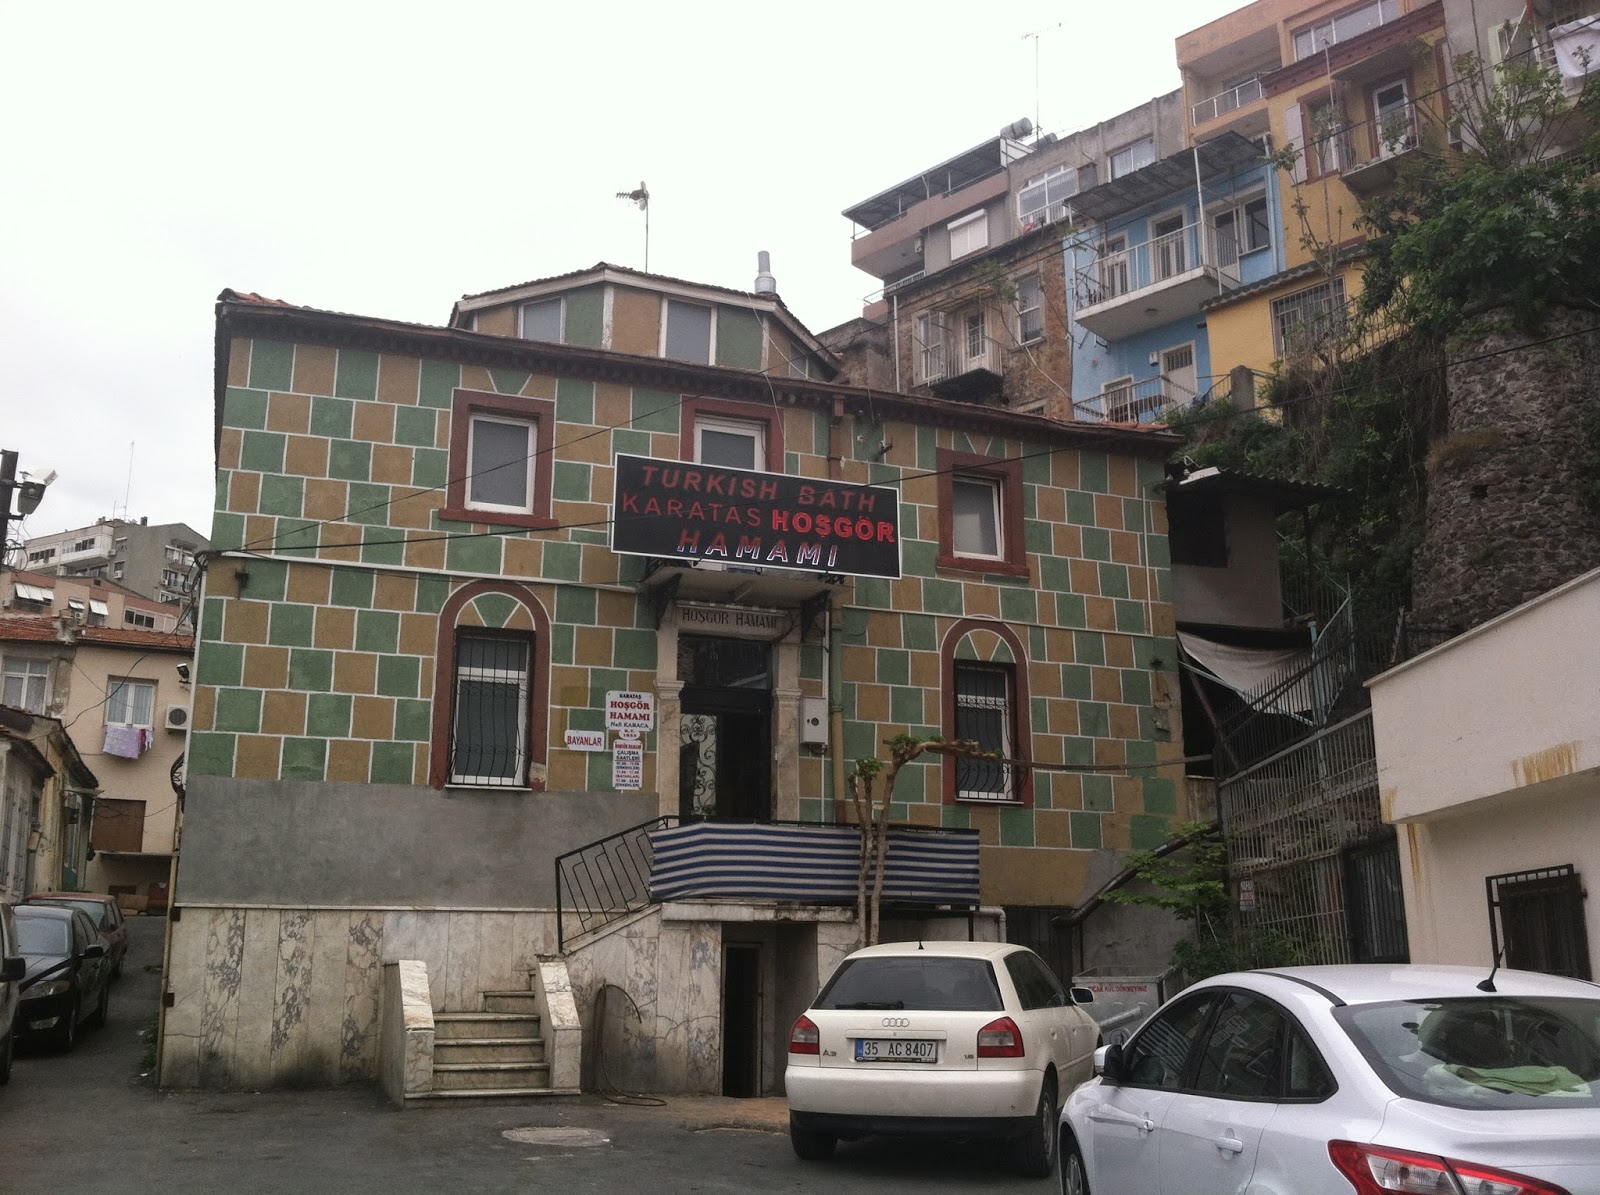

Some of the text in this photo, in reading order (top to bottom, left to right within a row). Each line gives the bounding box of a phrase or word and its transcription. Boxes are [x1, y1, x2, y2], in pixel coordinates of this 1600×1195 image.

[642, 465, 877, 512] TURKISH BATH
[622, 492, 896, 543] KARATAS HOŞGÖR
[676, 528, 839, 568] HAMAMI
[735, 613, 777, 629] HAMAMI
[610, 700, 650, 711] HOŞGÖR
[610, 712, 651, 721] HAMAMI
[567, 735, 602, 747] BAYANLAR
[822, 1049, 837, 1057] A3
[864, 1042, 934, 1057] 35 AC 8407
